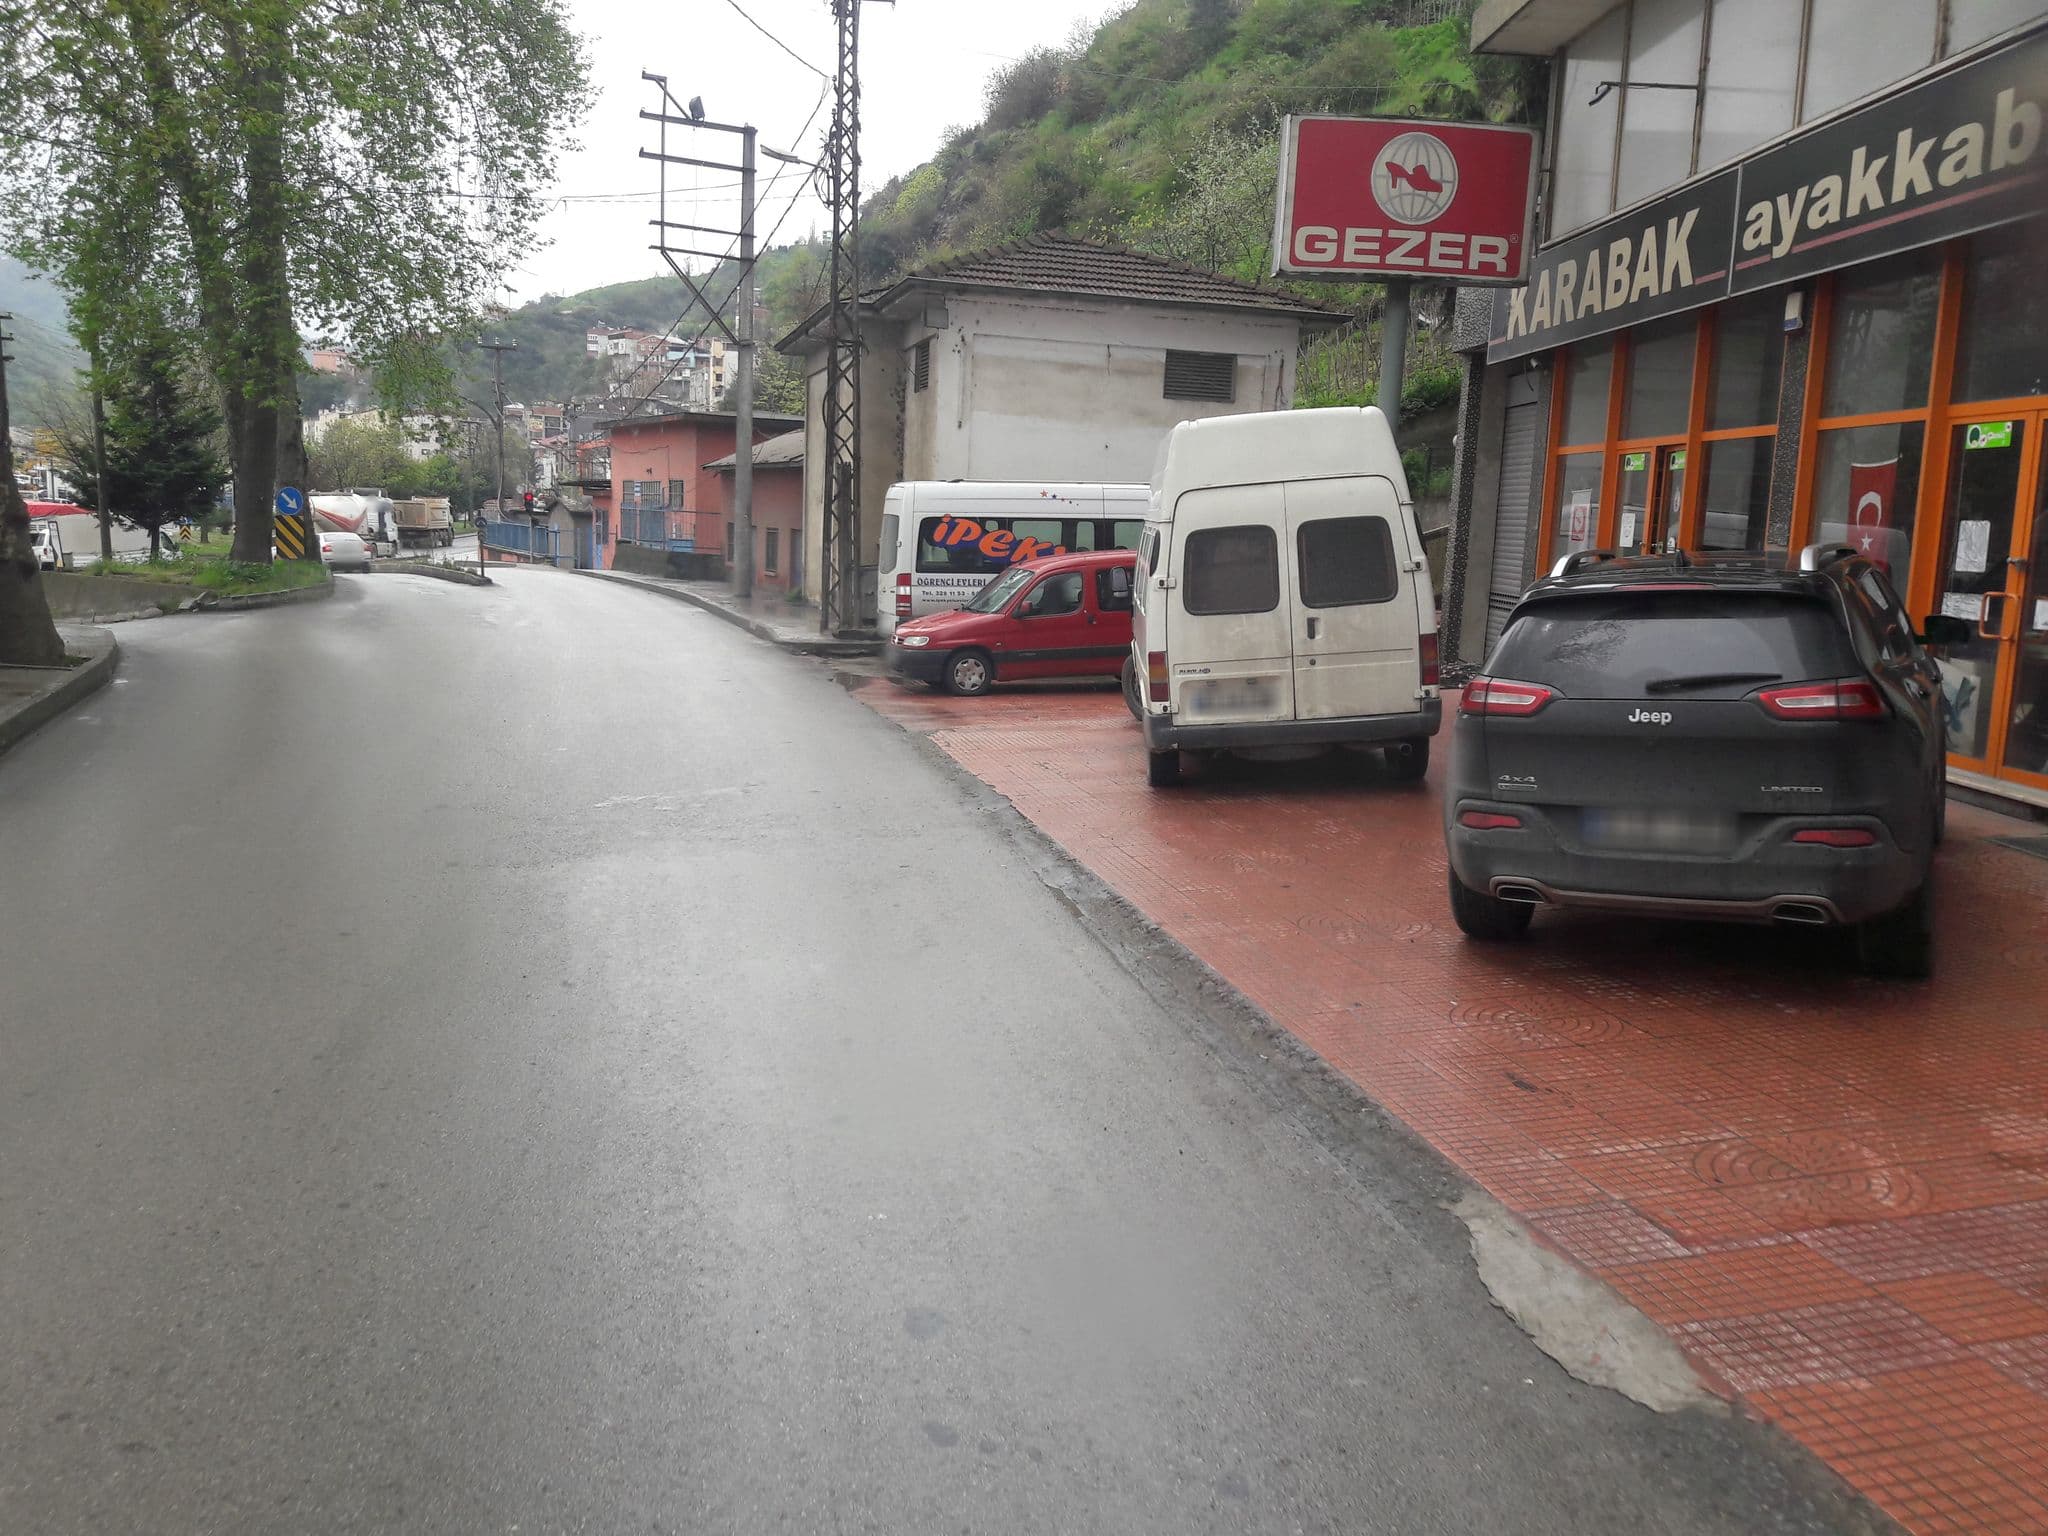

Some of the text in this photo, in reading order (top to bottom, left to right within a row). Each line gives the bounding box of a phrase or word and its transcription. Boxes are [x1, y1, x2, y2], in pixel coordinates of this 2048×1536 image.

[1741, 88, 2041, 259] ayakkab
[1294, 226, 1510, 273] GEZER
[1506, 208, 1701, 341] KARABAK
[1628, 708, 1672, 726] Jeep
[1760, 785, 1824, 793] LIMITED
